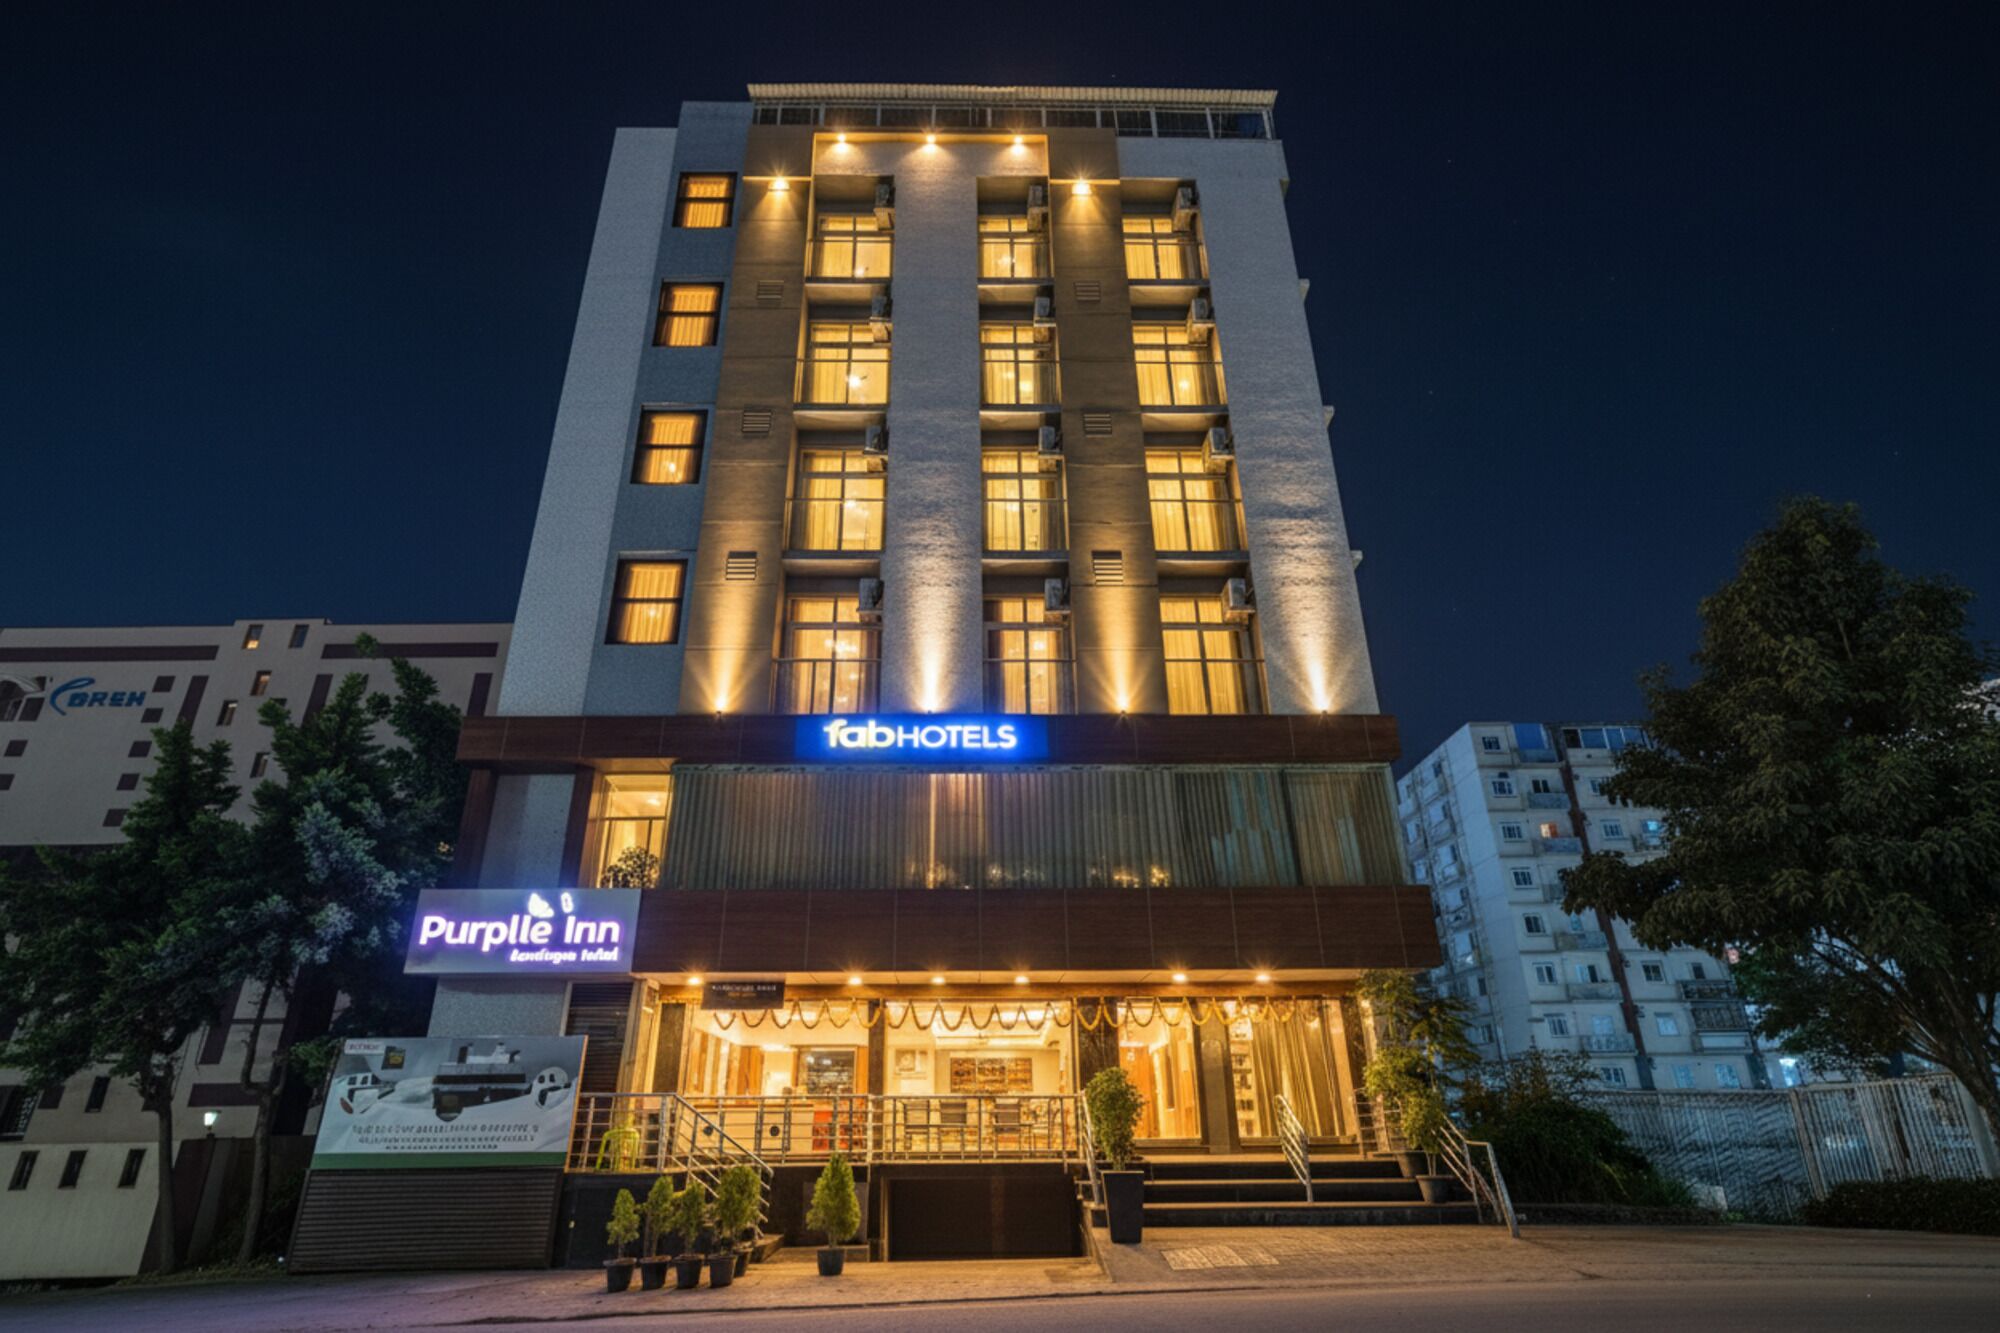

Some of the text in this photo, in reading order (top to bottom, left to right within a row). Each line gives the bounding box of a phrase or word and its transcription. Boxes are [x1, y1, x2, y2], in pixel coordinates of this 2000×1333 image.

[823, 718, 1018, 749] fabHOTELS
[419, 914, 621, 953] Purplle Inn
